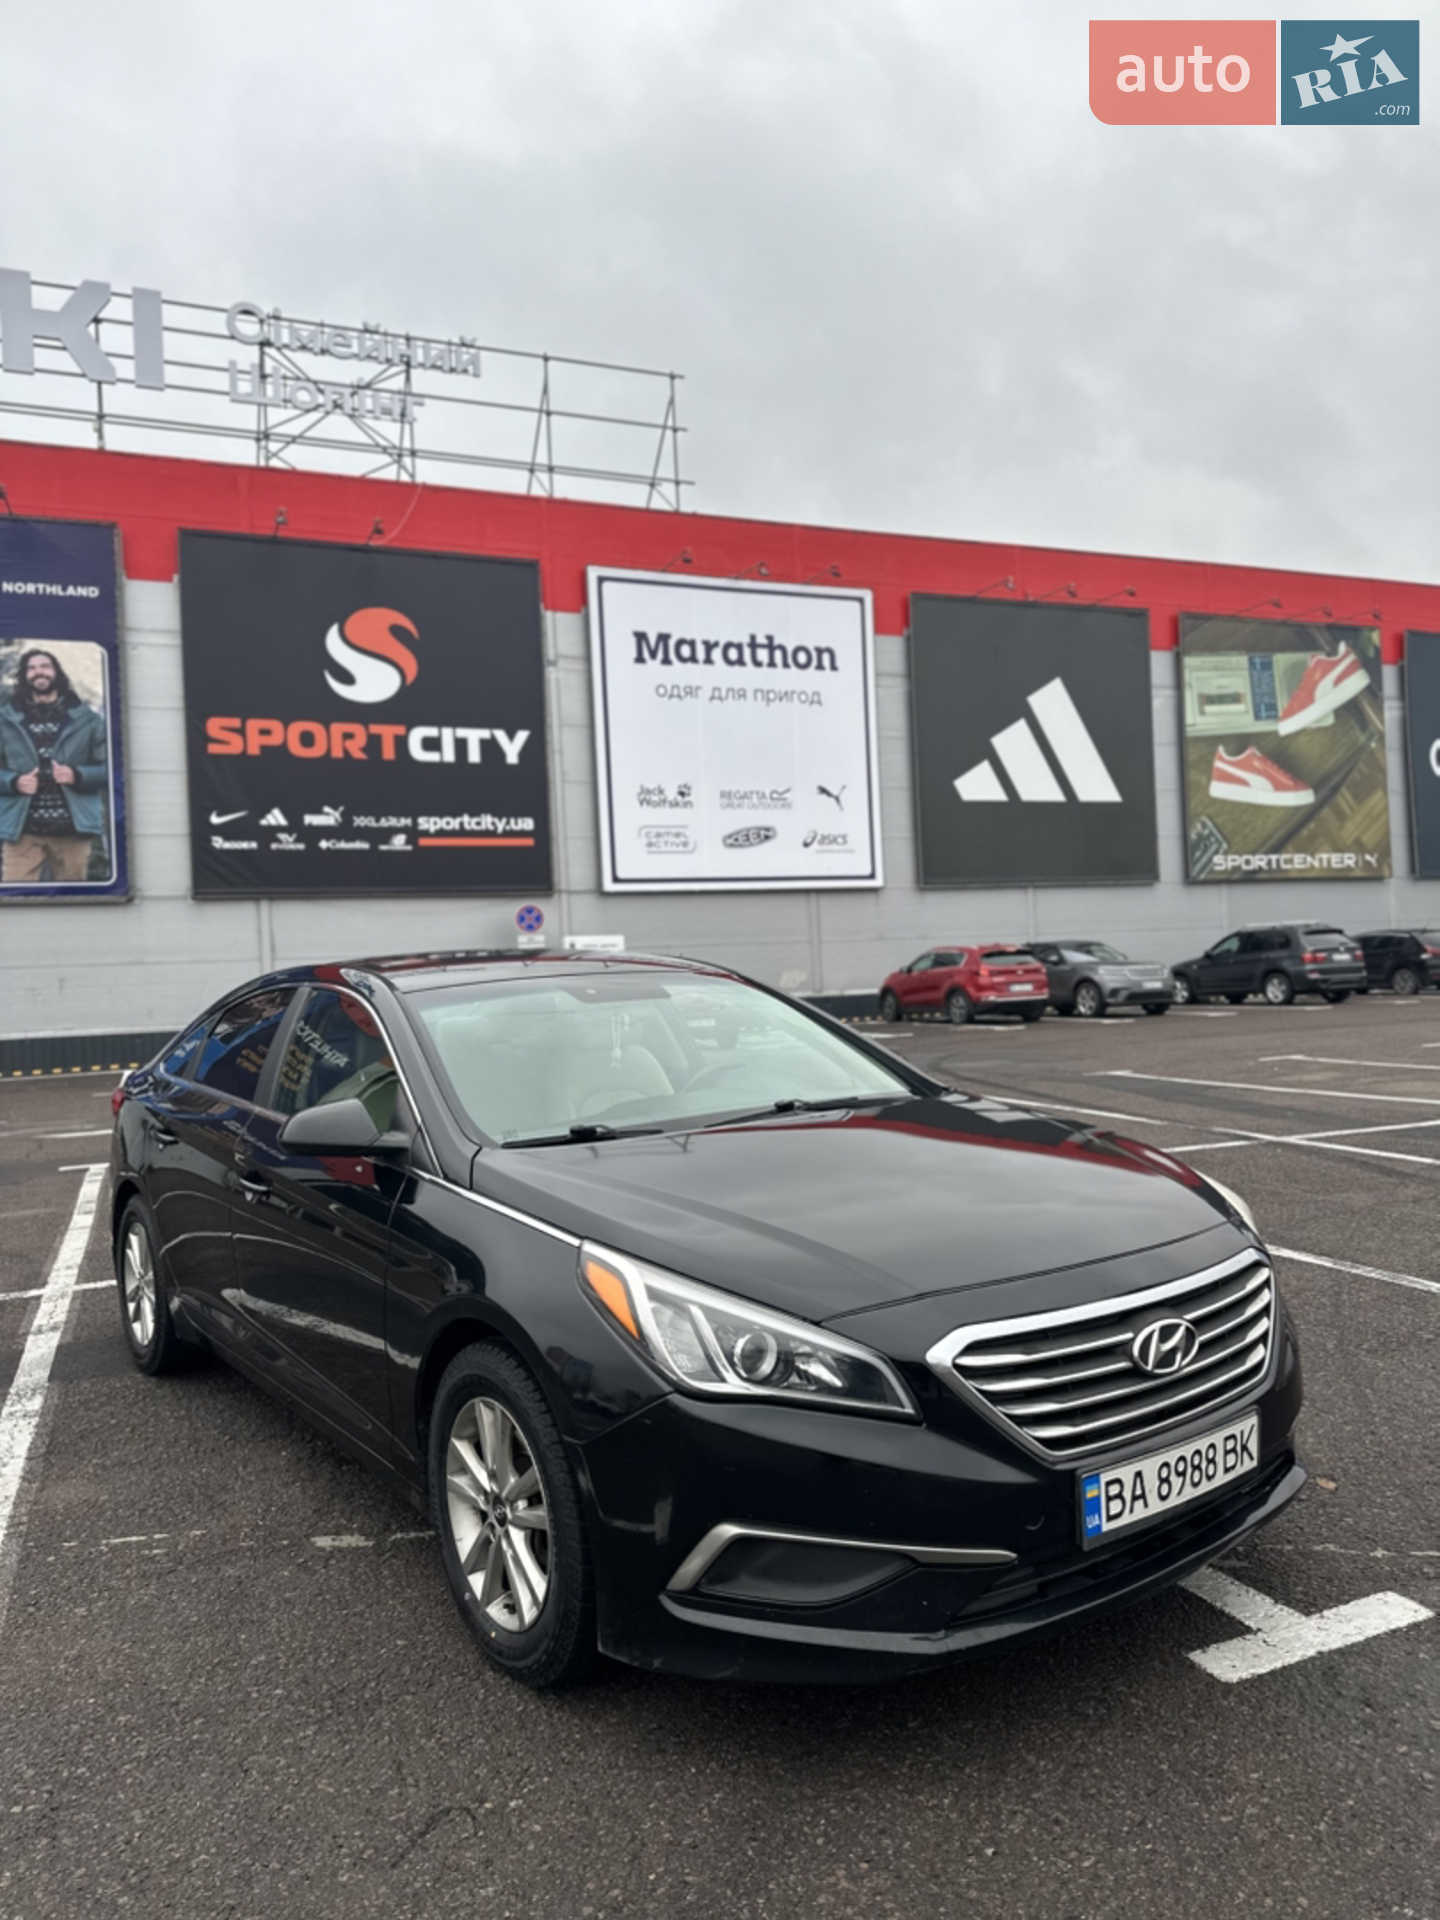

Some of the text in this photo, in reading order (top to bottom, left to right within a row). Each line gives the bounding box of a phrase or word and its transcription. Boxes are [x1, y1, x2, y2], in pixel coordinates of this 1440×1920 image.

[226, 301, 481, 377] Сімейний
[228, 358, 424, 423] Шопінг
[2, 581, 100, 598] NORTHLAND
[632, 631, 839, 671] Marathon
[655, 683, 824, 707] одяг для пригод
[205, 716, 532, 765] SPORTCITY
[637, 784, 666, 798] Jack
[719, 790, 767, 801] REGATTA
[637, 796, 693, 810] Wolfskin
[417, 812, 535, 834] sportcity.ua
[724, 828, 775, 847] KEEN
[1212, 852, 1356, 871] SPORTCENTER
[1104, 1469, 1149, 1523] BA
[1156, 1442, 1218, 1503] 8988
